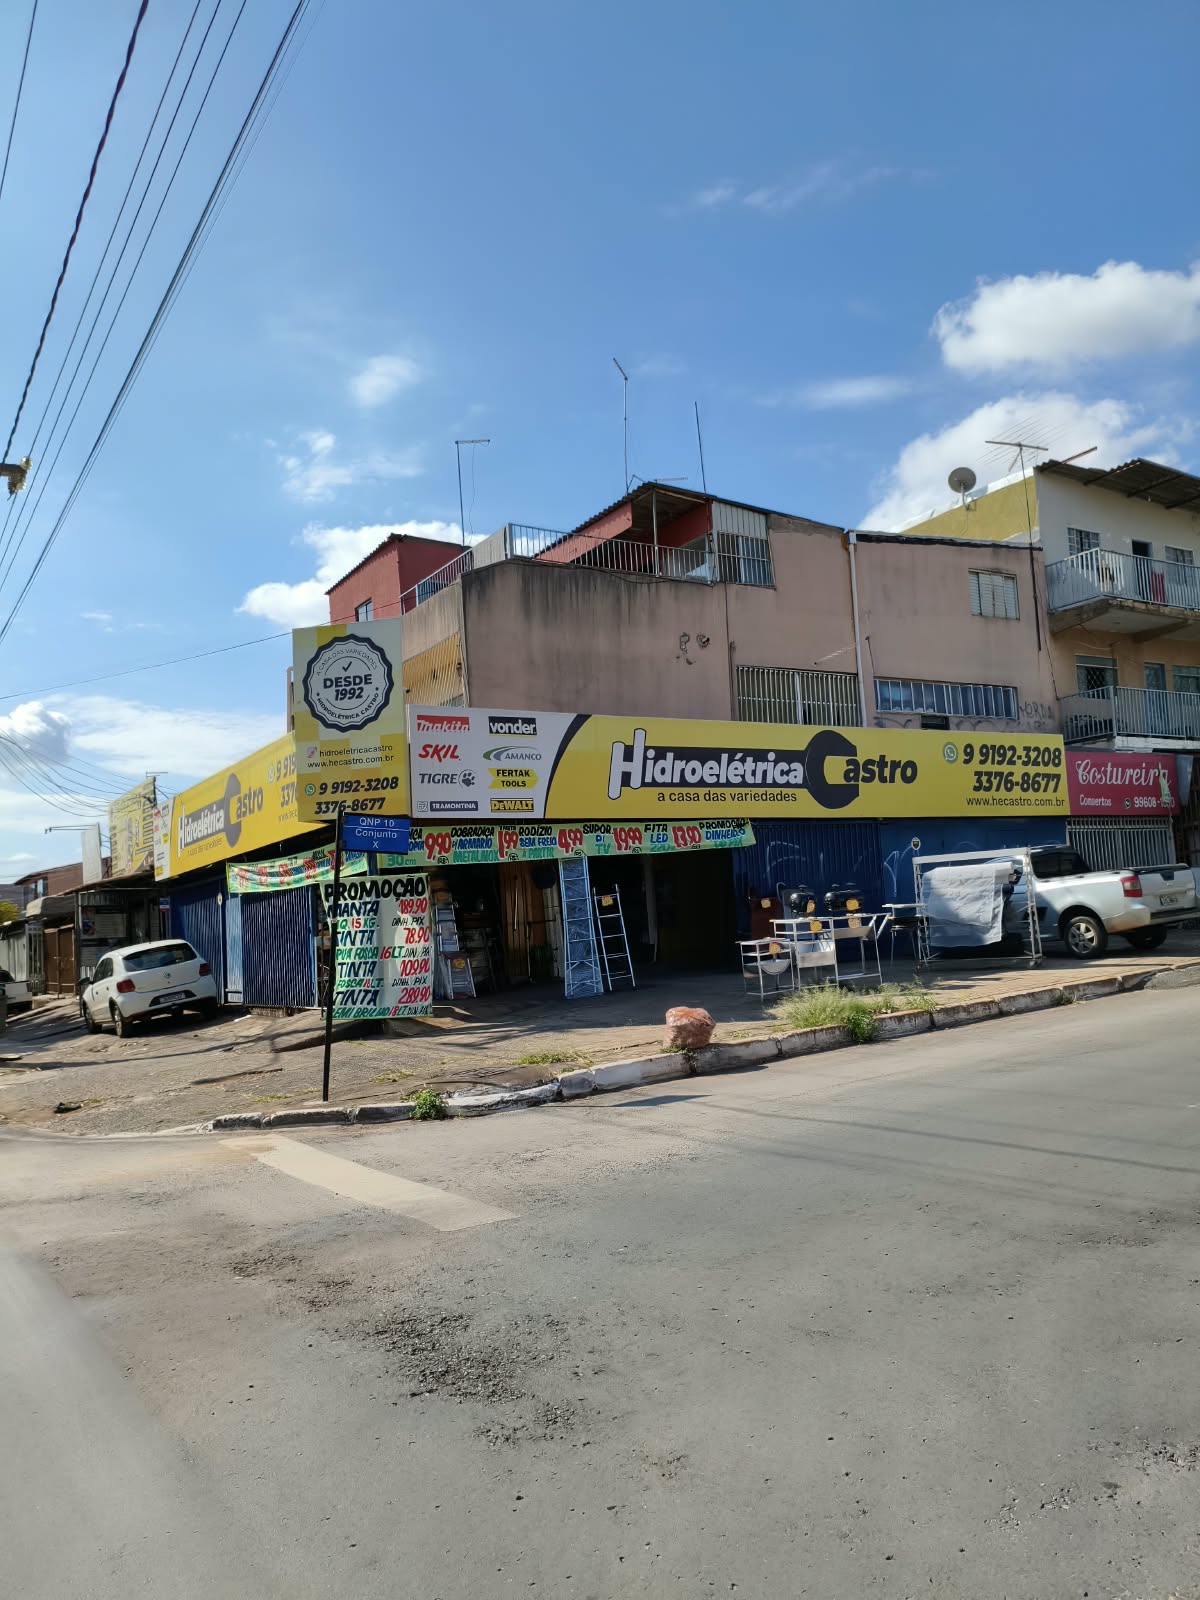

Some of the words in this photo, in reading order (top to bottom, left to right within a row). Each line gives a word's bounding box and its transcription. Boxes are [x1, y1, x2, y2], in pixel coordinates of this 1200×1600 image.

[323, 673, 373, 689] DESDE
[335, 686, 364, 701] 1992
[317, 697, 360, 720] HIDROELÉTRICA
[360, 692, 379, 715] CASTRO
[417, 718, 470, 732] makita
[490, 719, 536, 734] vonder
[319, 744, 393, 757] hidroeletricacastro
[418, 743, 460, 762] SKIL
[504, 753, 542, 761] AMANCO
[963, 743, 974, 765] 9
[978, 743, 1062, 767] 9192-3208
[307, 754, 394, 768] www.hecastro.com.br
[608, 728, 803, 800] Hidroelétrica
[419, 773, 458, 784] TIGRE
[496, 769, 530, 777] FERTAK
[319, 782, 328, 795] 9
[331, 776, 399, 794] 9192-3208
[972, 770, 1061, 793] 3376-8677
[658, 793, 665, 802] a
[669, 792, 701, 802] casa
[703, 790, 726, 802] das
[730, 789, 797, 802] variedades
[966, 795, 1065, 807] www.hecastro.com.br
[314, 797, 386, 815] 3376-8677
[360, 817, 380, 826] QNP
[384, 819, 395, 827] 10
[644, 823, 668, 833] FITA
[177, 803, 225, 859] Hidroelétrica
[355, 828, 397, 839] Conjunto
[451, 826, 495, 838] DOBRADIÇA
[519, 825, 552, 837] RODÍZIO
[650, 833, 668, 843] LED
[372, 840, 379, 849] X
[595, 843, 611, 854] TV
[324, 874, 426, 902] PROMOÇÃO
[327, 900, 380, 917] MANTA
[351, 918, 362, 929] 15
[338, 961, 377, 978] TINTA
[333, 989, 380, 1006] TINTA
[333, 1006, 353, 1018] EMI
